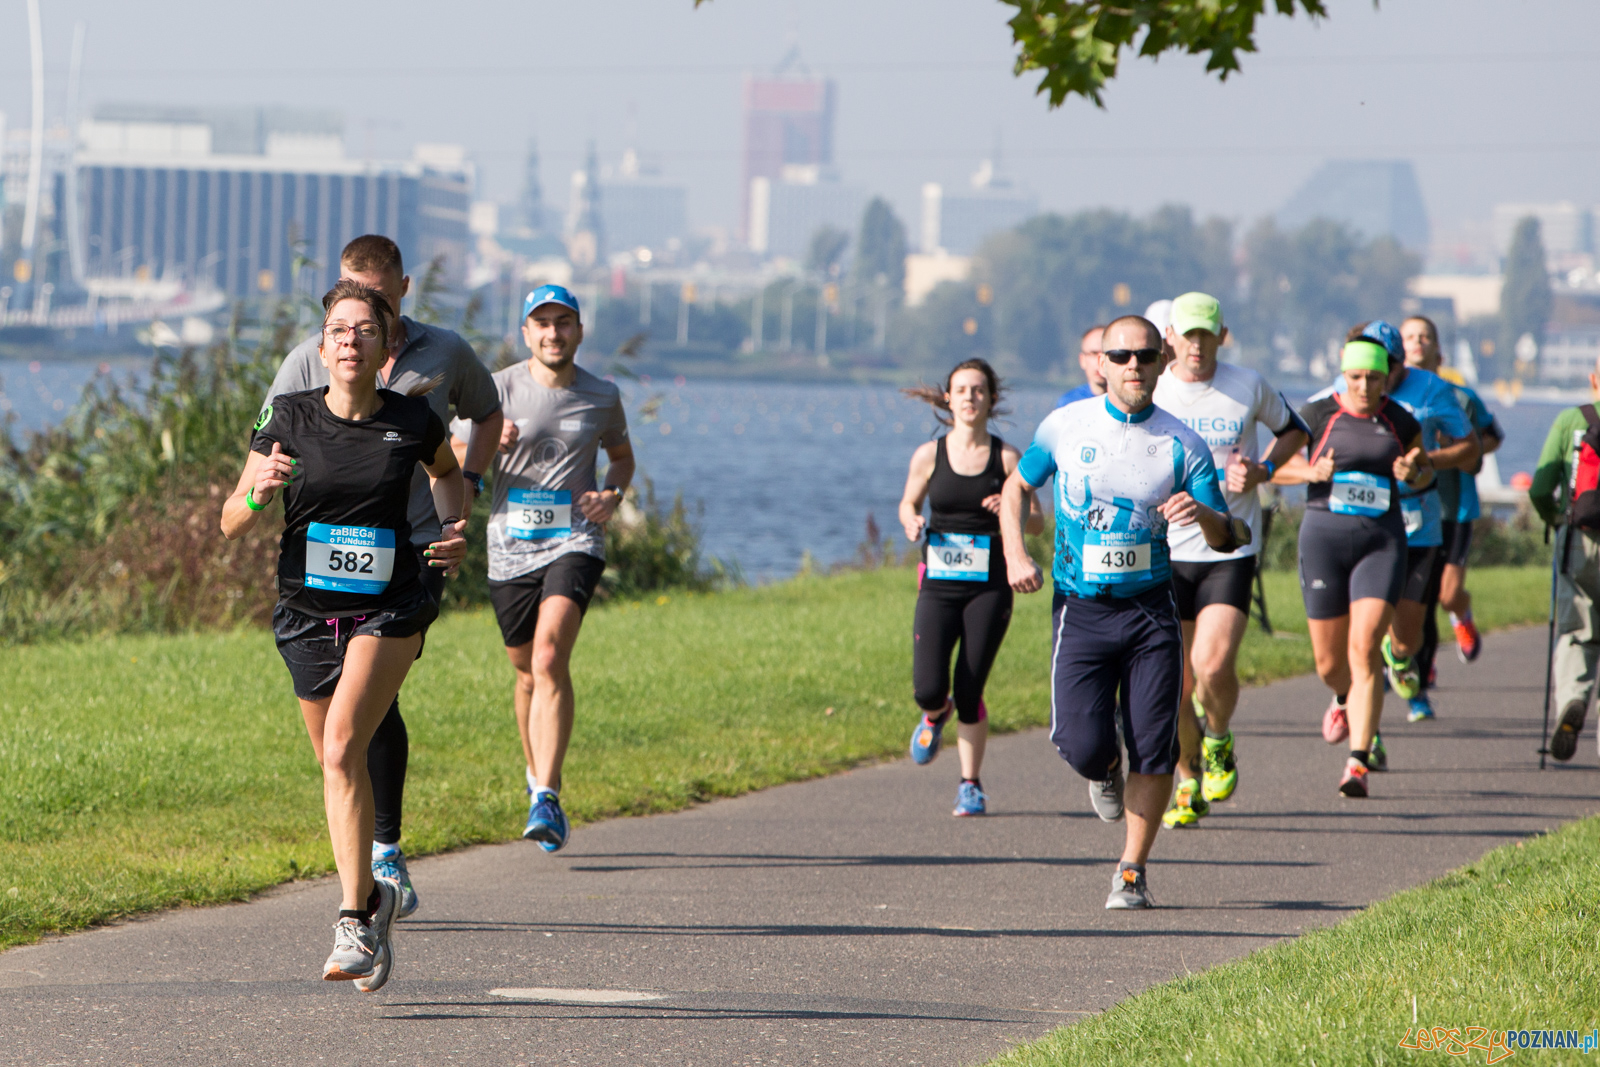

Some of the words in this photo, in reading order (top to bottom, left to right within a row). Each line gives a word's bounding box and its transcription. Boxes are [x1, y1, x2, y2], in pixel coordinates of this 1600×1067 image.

[1347, 487, 1375, 504] 549
[522, 509, 554, 525] 539
[330, 527, 376, 541] zaBIEGaj
[337, 536, 375, 546] FUNdusze
[1101, 532, 1136, 541] zaBIEGaj
[328, 550, 374, 574] 582
[944, 551, 973, 566] 045
[1101, 550, 1136, 567] 430
